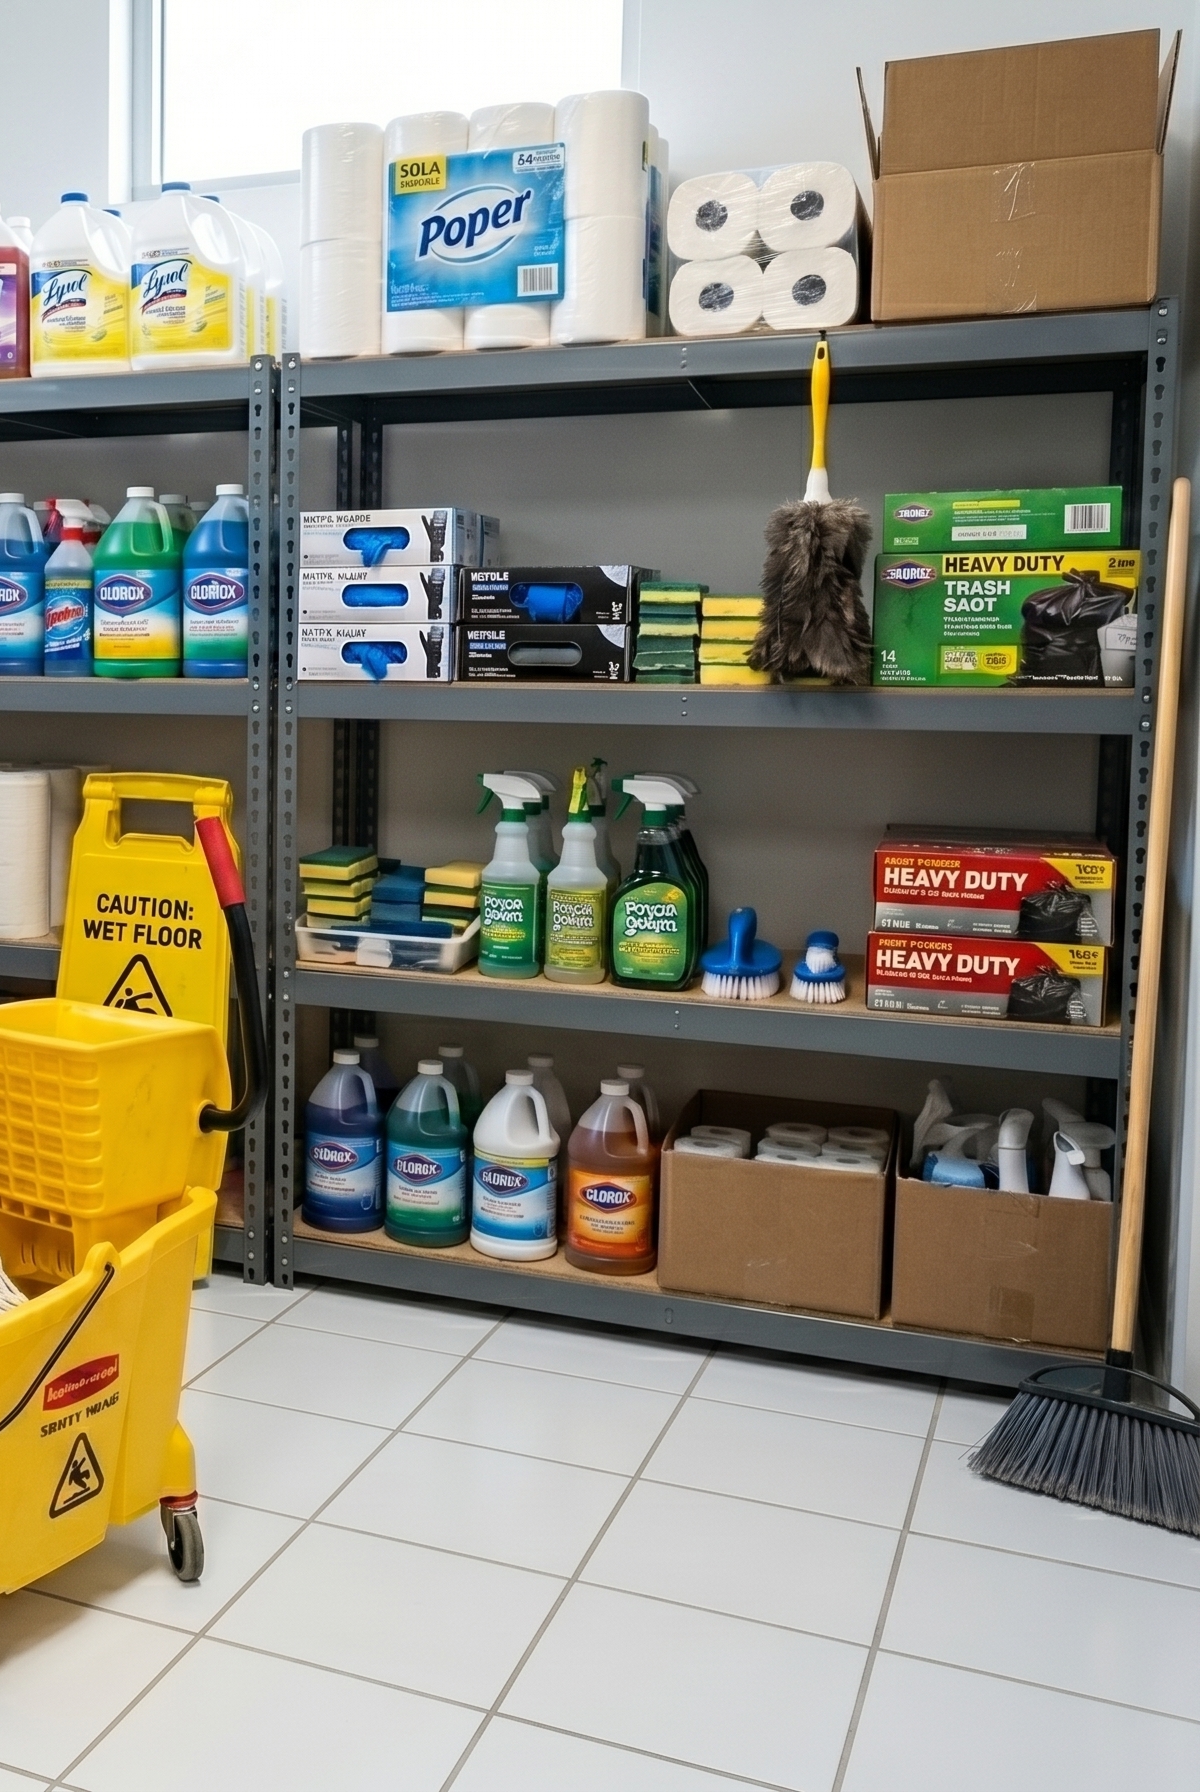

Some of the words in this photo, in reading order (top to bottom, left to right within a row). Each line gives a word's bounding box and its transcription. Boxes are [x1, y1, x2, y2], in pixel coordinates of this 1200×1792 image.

[400, 161, 441, 178] SOLA
[418, 189, 532, 258] Poper
[945, 556, 1008, 573] HEAVY
[1013, 555, 1065, 572] DUTY
[943, 580, 1011, 596] TRASH
[943, 597, 998, 613] SAOT
[880, 650, 897, 662] 14
[884, 867, 961, 889] HEAVY
[964, 870, 1029, 892] DUTY
[96, 893, 194, 921] CAUTION:
[82, 918, 128, 942] WET
[133, 923, 203, 950] FLOOR
[876, 949, 953, 972] HEAVY
[956, 954, 1021, 976] DUTY
